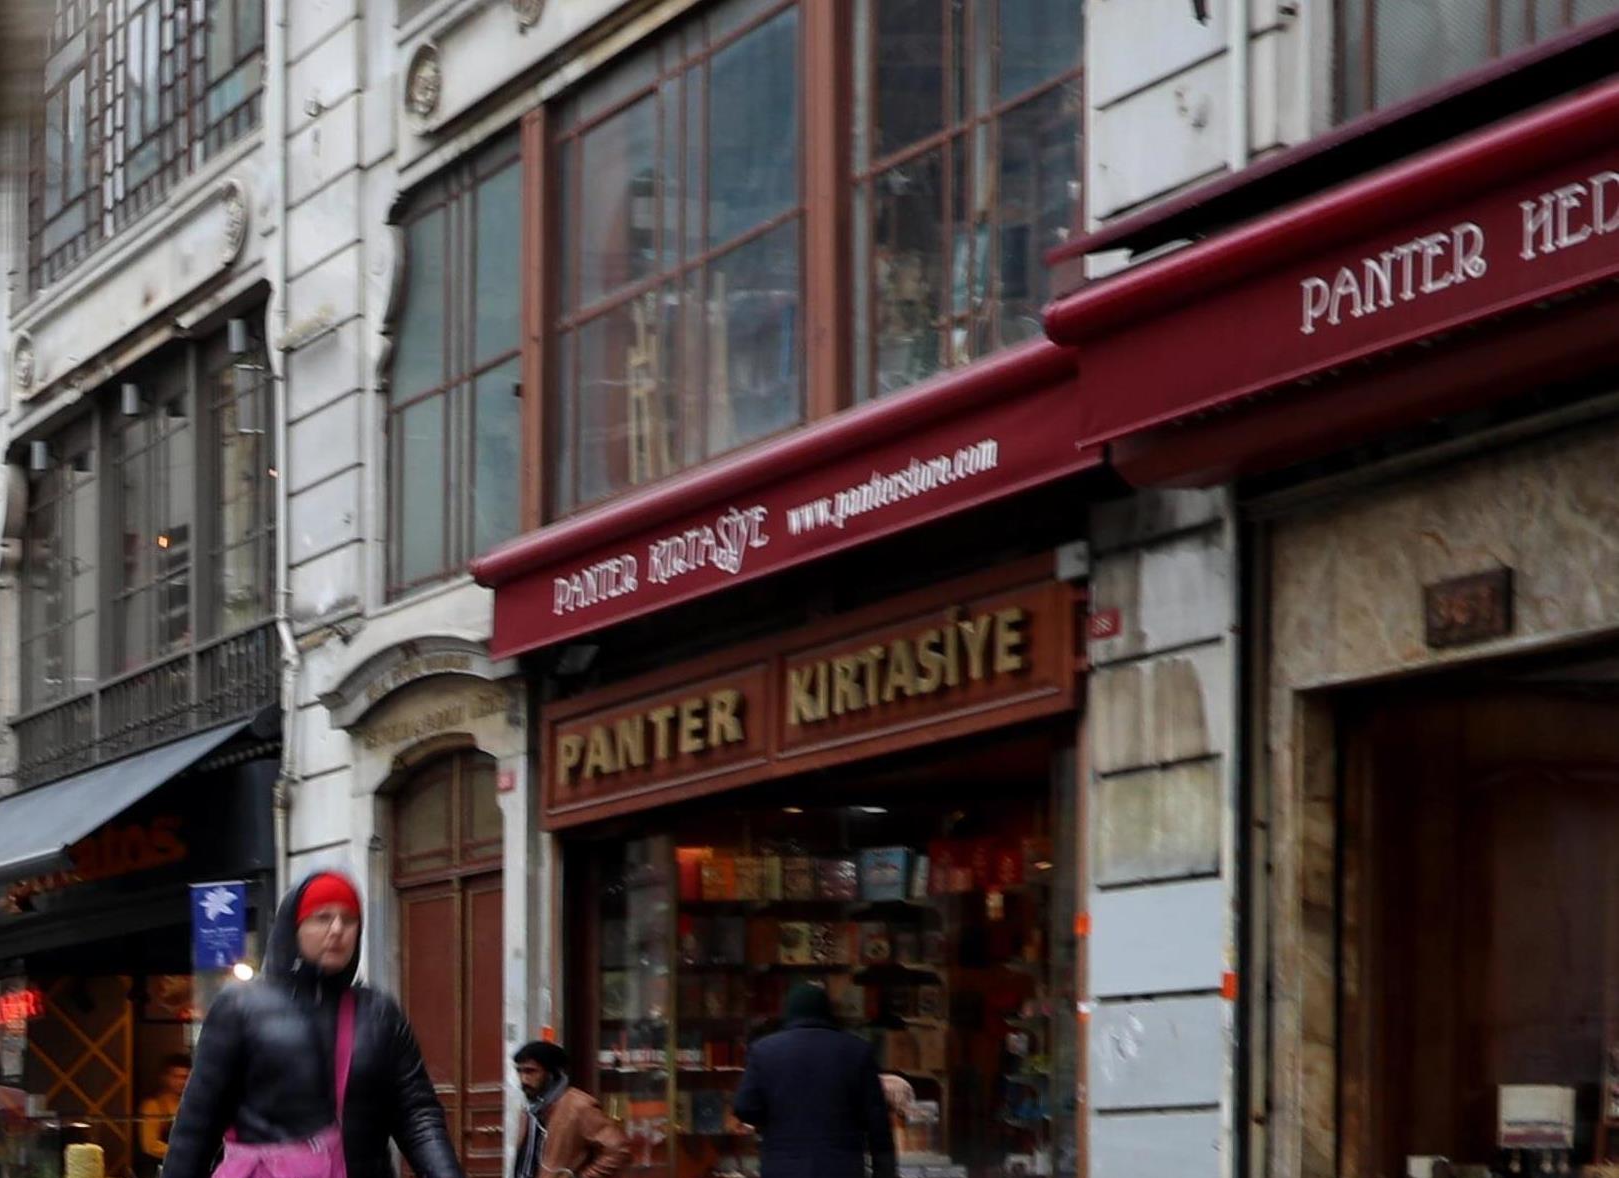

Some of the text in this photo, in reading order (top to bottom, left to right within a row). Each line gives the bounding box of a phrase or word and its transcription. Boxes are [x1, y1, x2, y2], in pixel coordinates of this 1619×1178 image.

[1300, 221, 1487, 335] PANTER
[552, 553, 639, 616] PANTER
[786, 438, 999, 536] www.panterstore.com
[556, 604, 1025, 786] PANTER KIRTASİYE
